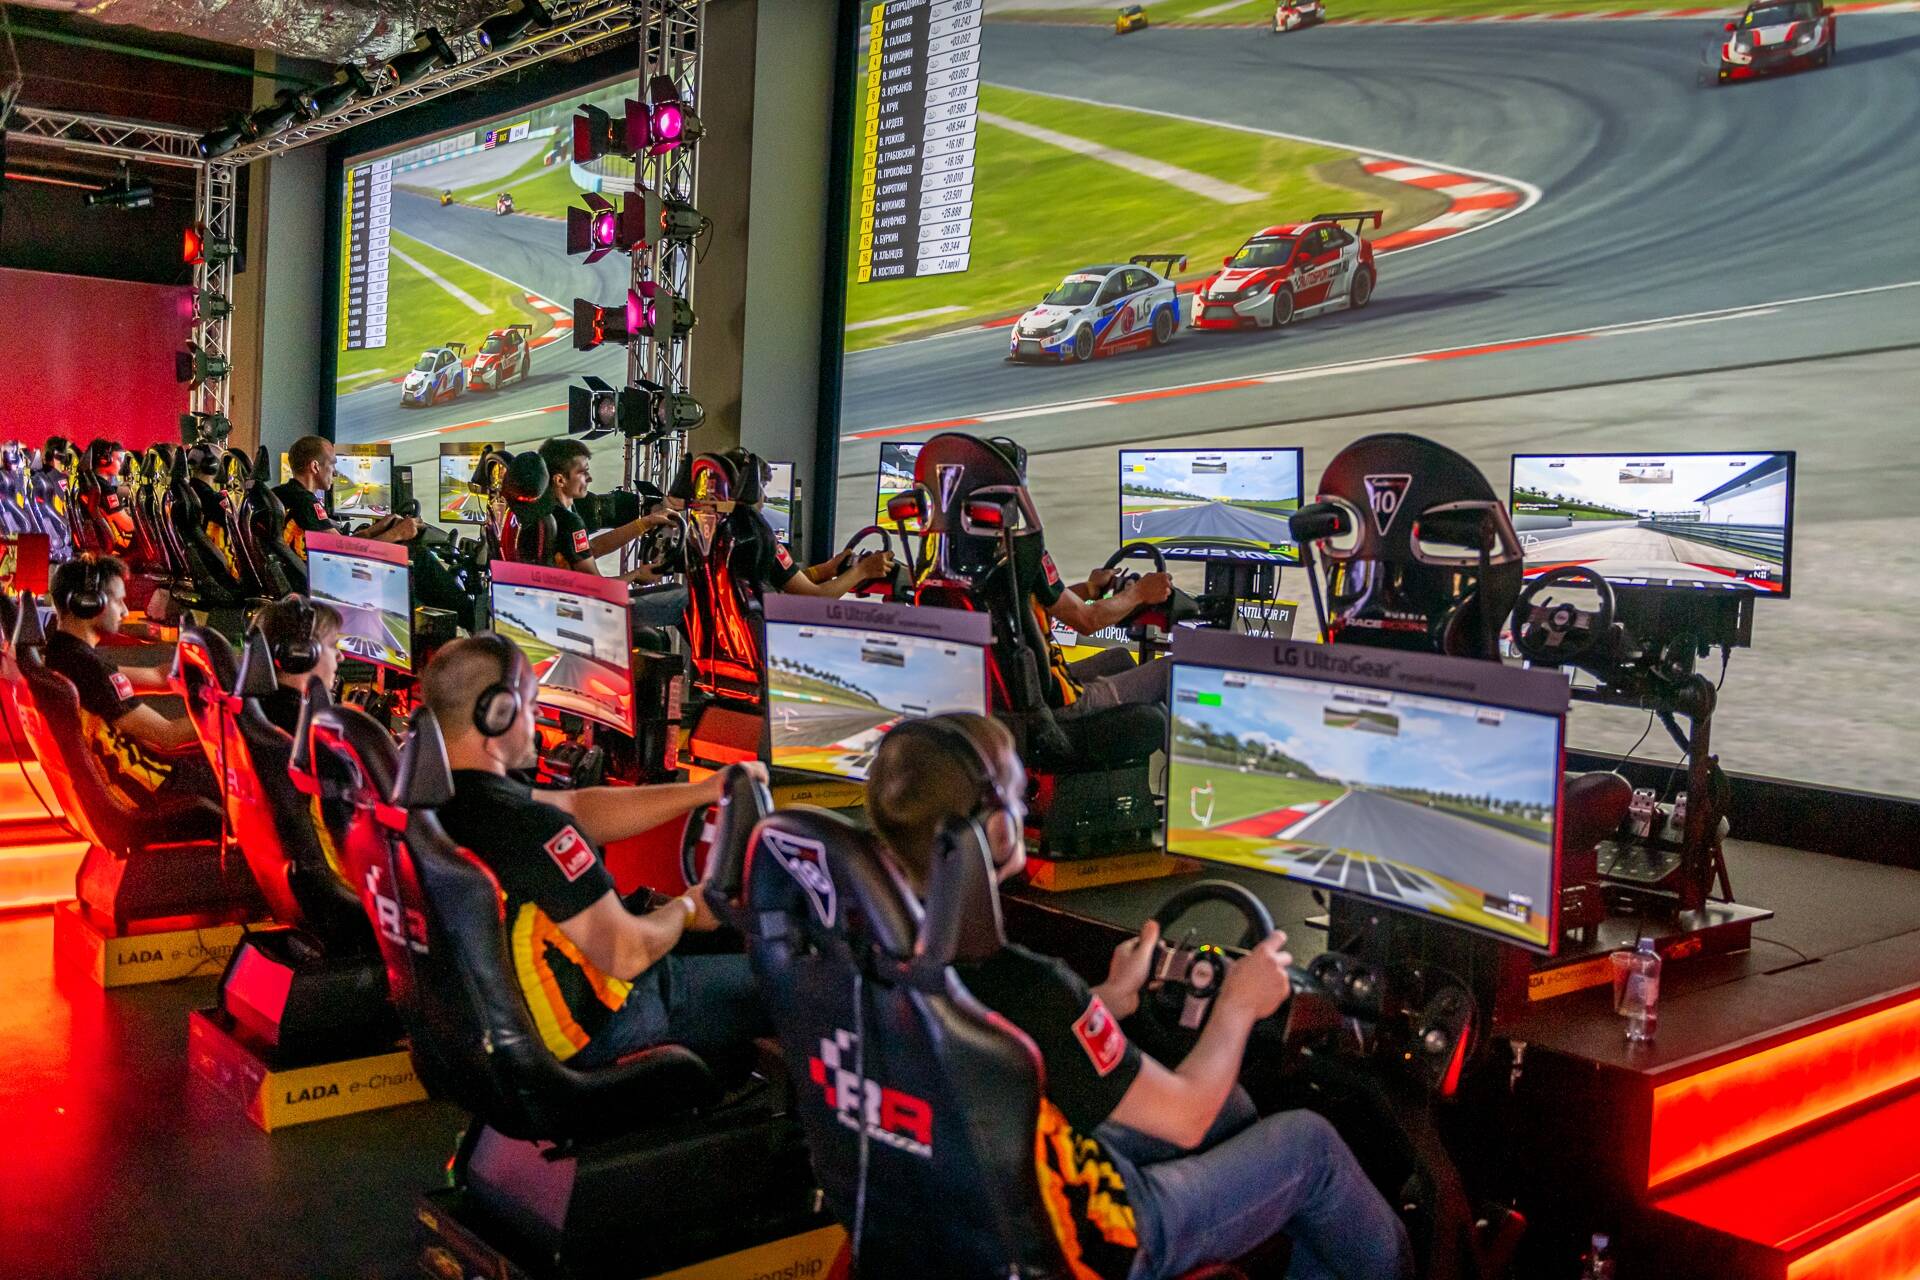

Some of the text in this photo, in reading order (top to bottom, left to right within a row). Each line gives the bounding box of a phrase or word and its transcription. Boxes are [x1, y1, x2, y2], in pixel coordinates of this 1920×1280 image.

[883, 164, 913, 179] ПРОКОФЬЕВ
[1374, 490, 1397, 514] 10
[826, 605, 896, 625] LG UltraGear
[1279, 609, 1289, 622] P1
[1095, 626, 1130, 643] ОГОРОД
[1273, 646, 1396, 678] LG UltraGear
[118, 950, 164, 965] LADA
[286, 1084, 340, 1105] LADA
